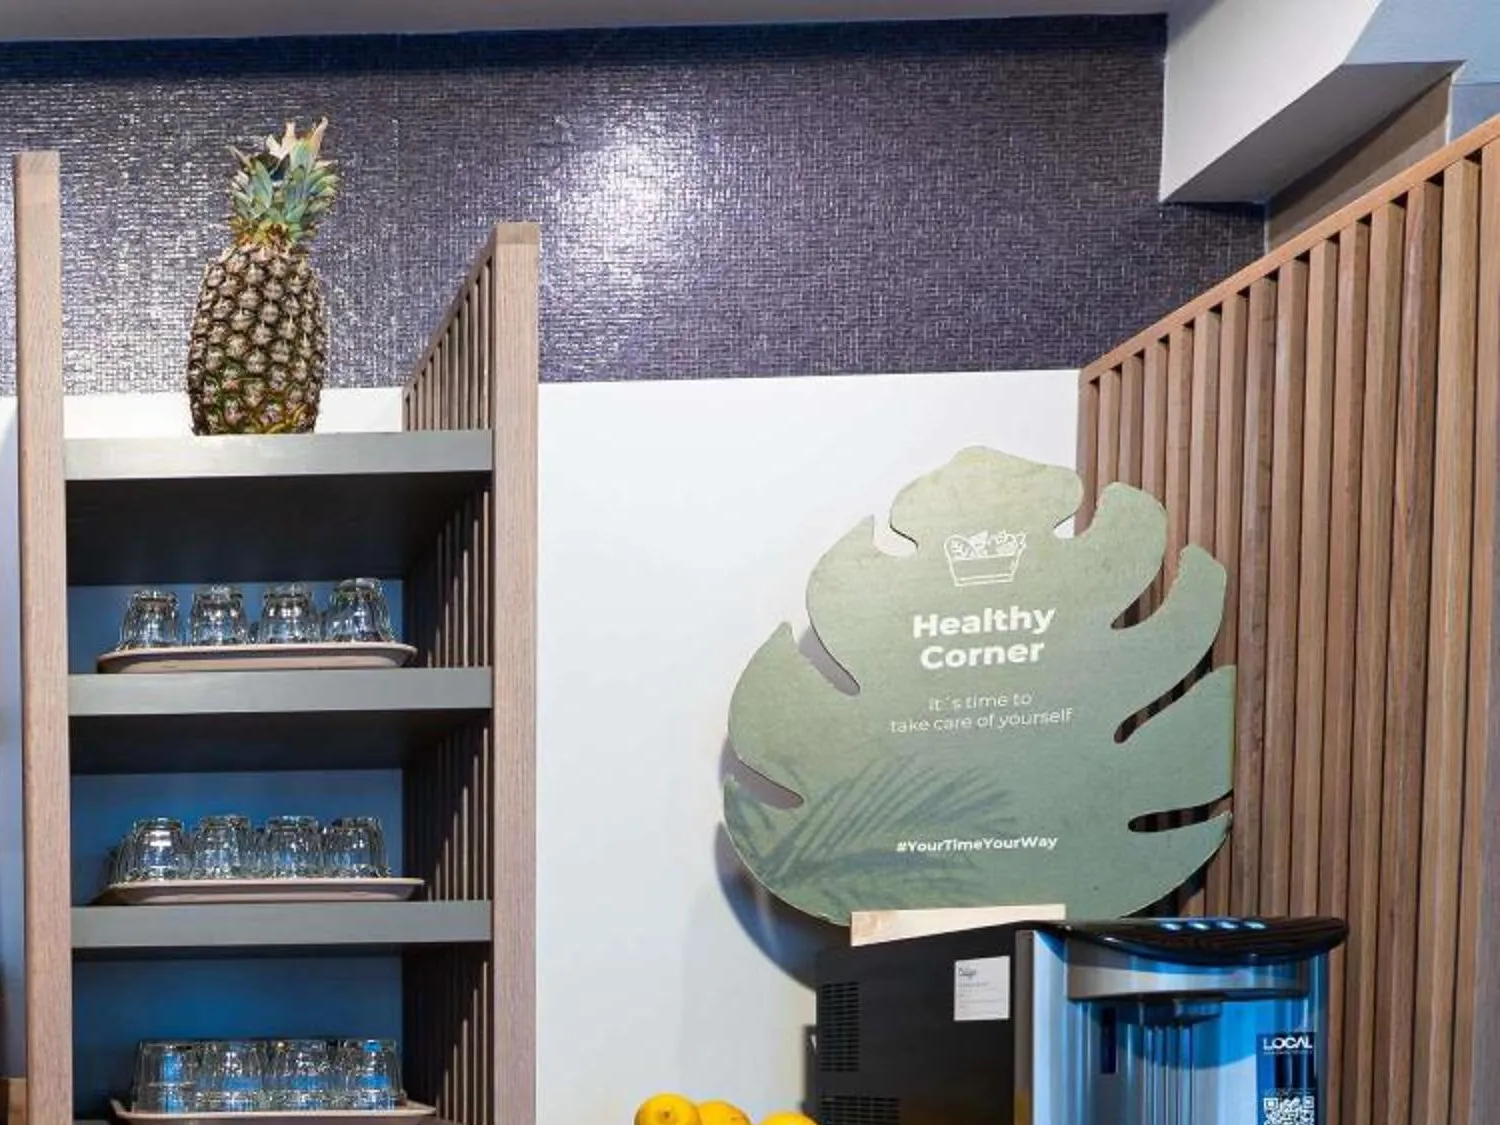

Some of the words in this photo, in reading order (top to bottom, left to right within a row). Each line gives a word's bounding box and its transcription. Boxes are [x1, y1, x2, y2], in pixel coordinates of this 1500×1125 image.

[913, 605, 1056, 639] Healthy
[920, 642, 1045, 670] Corner
[965, 693, 1008, 710] time
[1013, 691, 1033, 706] to
[890, 718, 930, 734] take
[934, 716, 972, 732] care
[976, 712, 994, 728] of
[998, 707, 1073, 729] yourself
[896, 835, 1059, 854] #YourTimeYourWay
[1263, 1036, 1313, 1050] LOCAL
